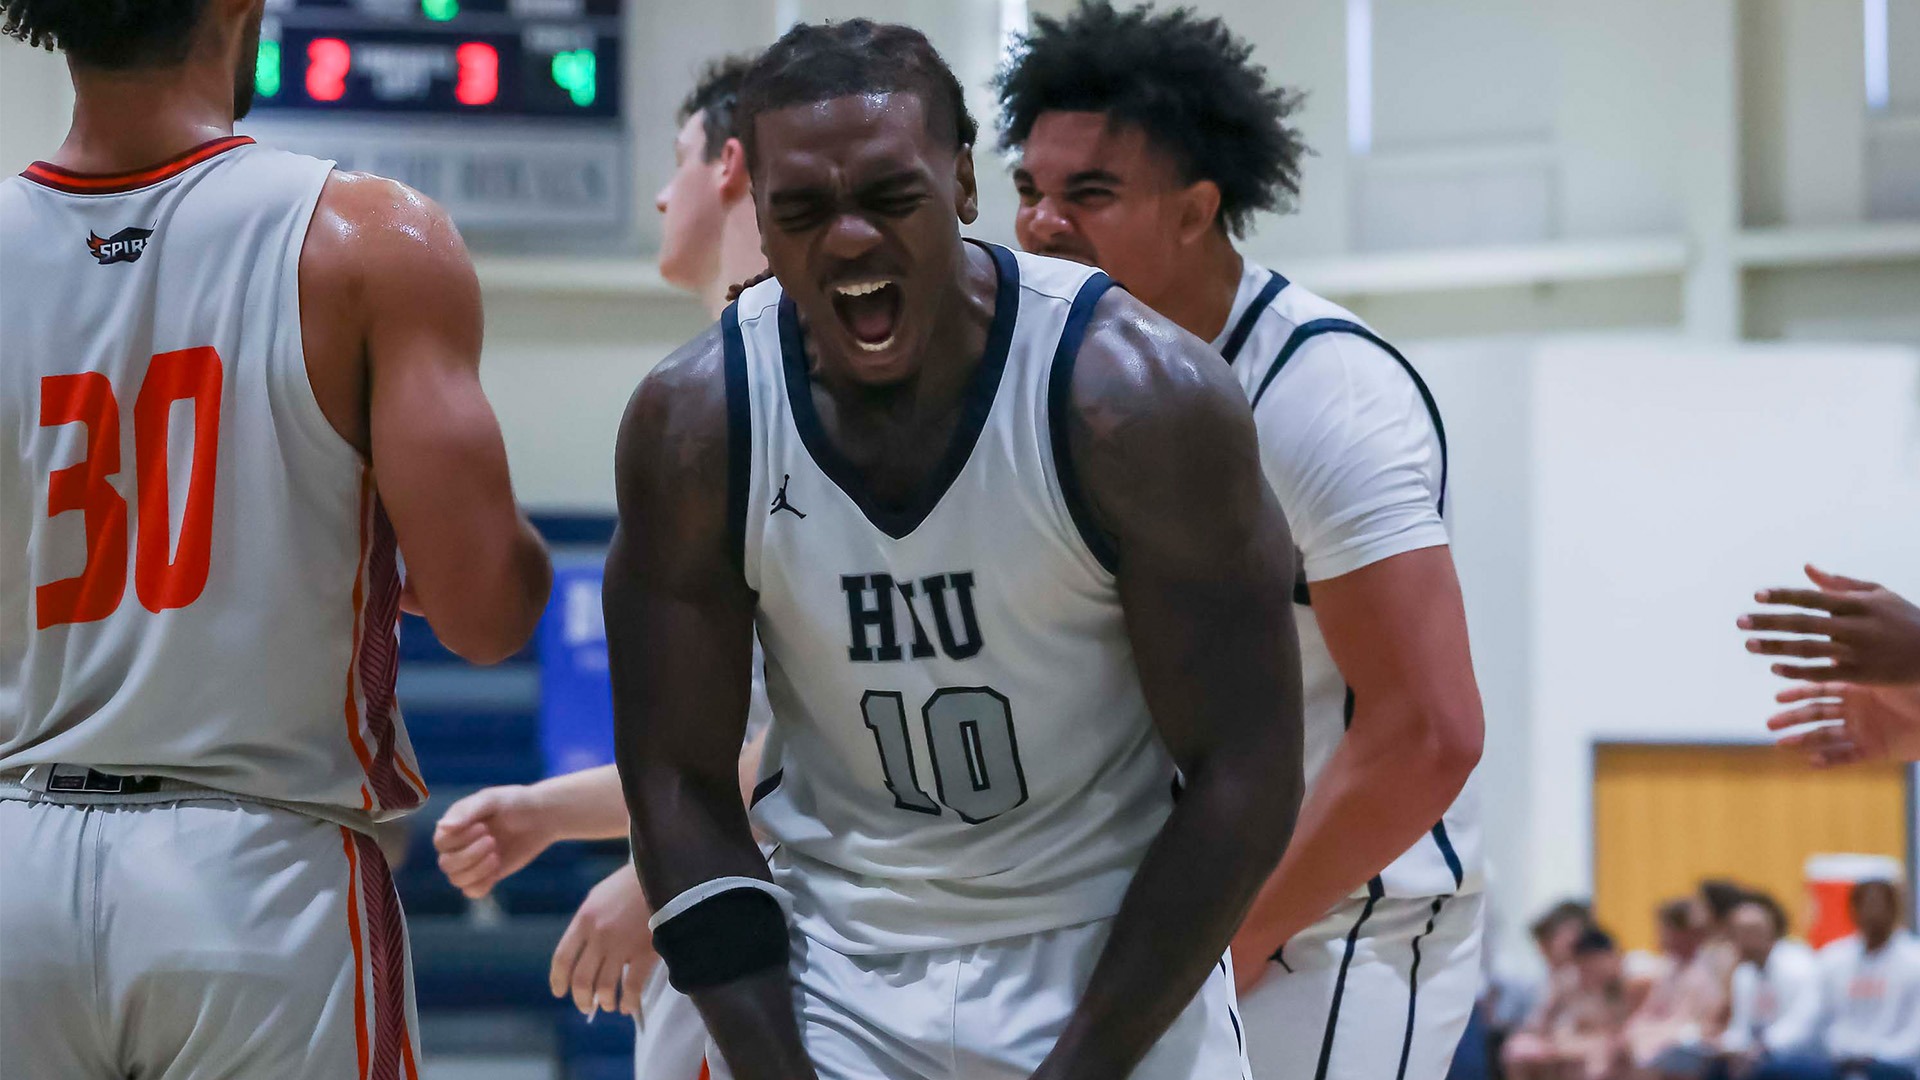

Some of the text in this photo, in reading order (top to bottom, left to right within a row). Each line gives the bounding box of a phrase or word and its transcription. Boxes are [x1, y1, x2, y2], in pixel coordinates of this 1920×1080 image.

[99, 237, 147, 257] SPIR
[36, 346, 223, 631] 30
[859, 686, 1029, 825] 10
